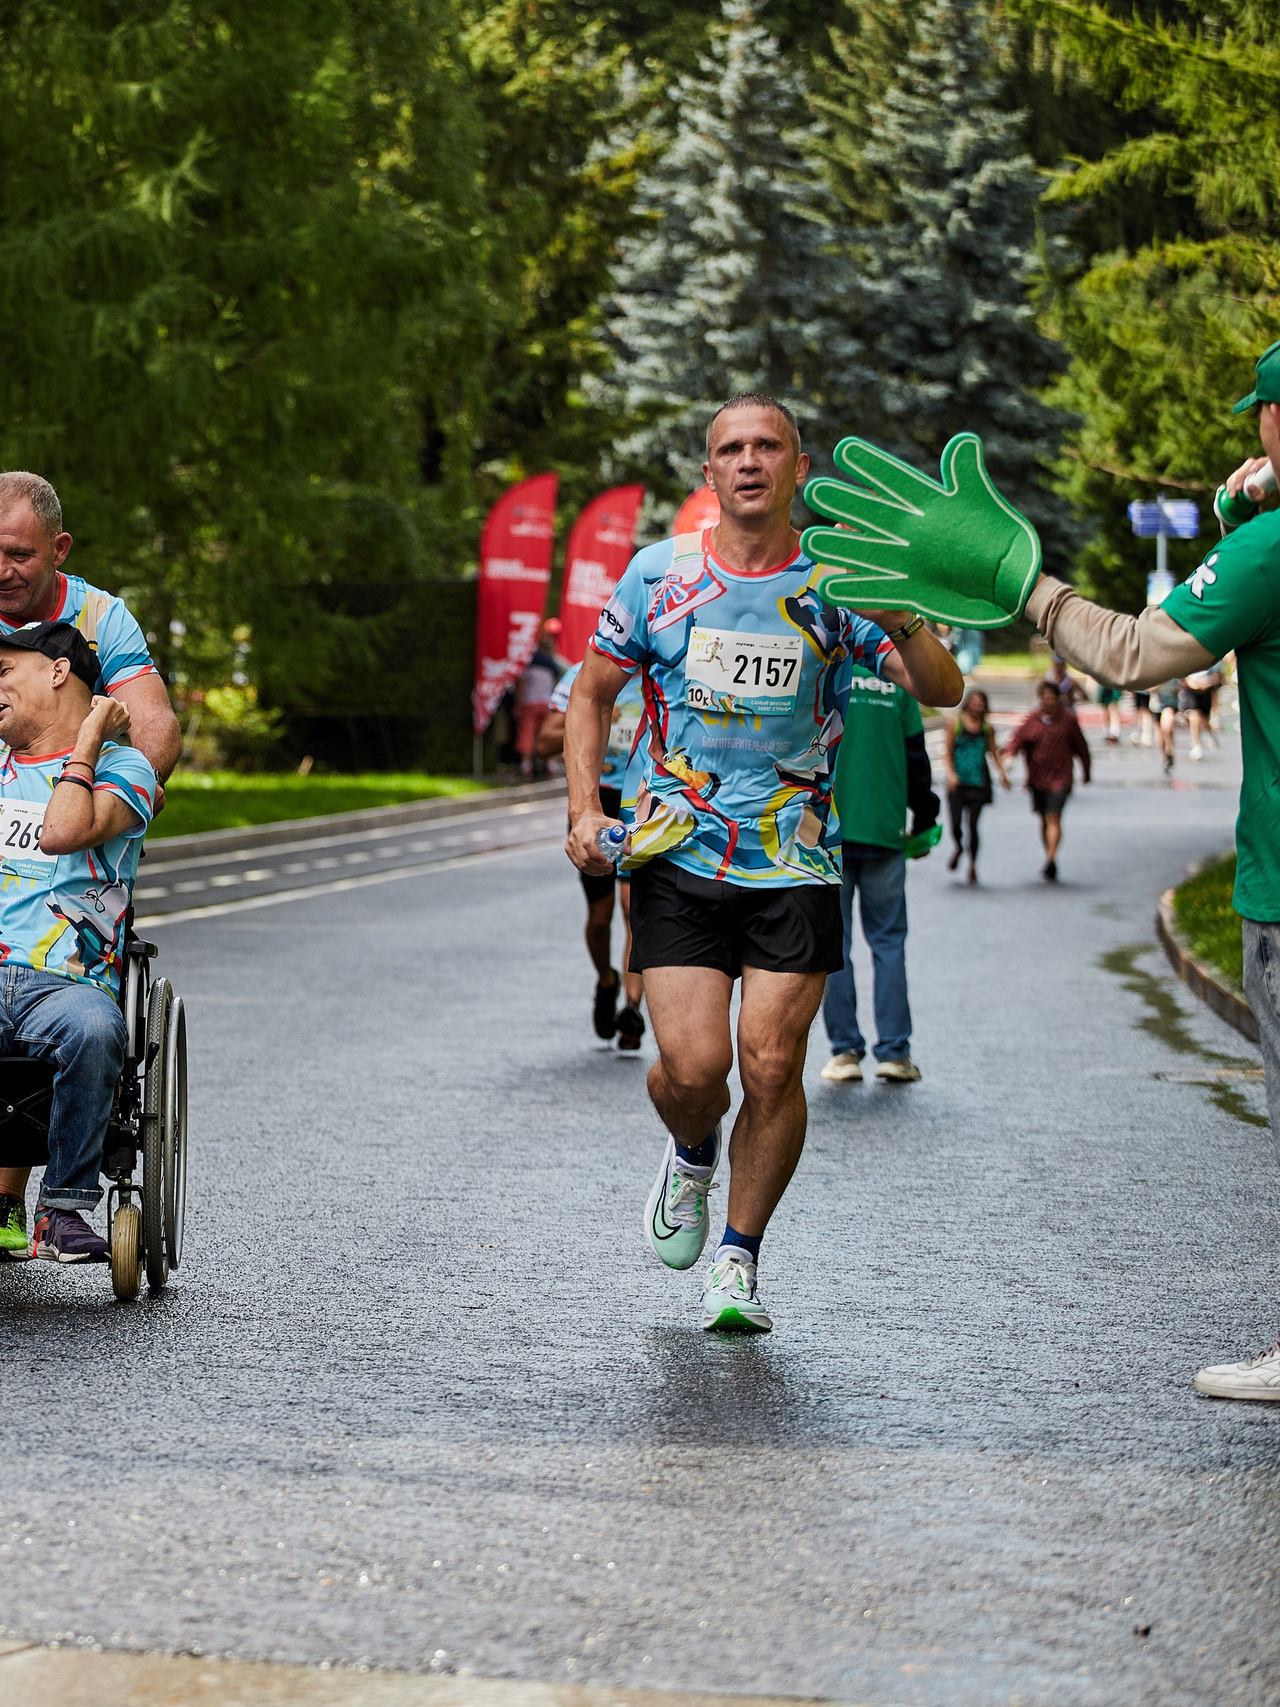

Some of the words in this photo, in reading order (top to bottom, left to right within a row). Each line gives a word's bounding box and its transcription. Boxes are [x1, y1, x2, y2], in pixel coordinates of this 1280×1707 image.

[600, 609, 624, 634] пер
[732, 654, 798, 688] 2157
[851, 676, 896, 695] пер
[701, 735, 775, 752] БЛАГОТВОРИТЕЛЬНЫЙ
[5, 820, 44, 851] 269
